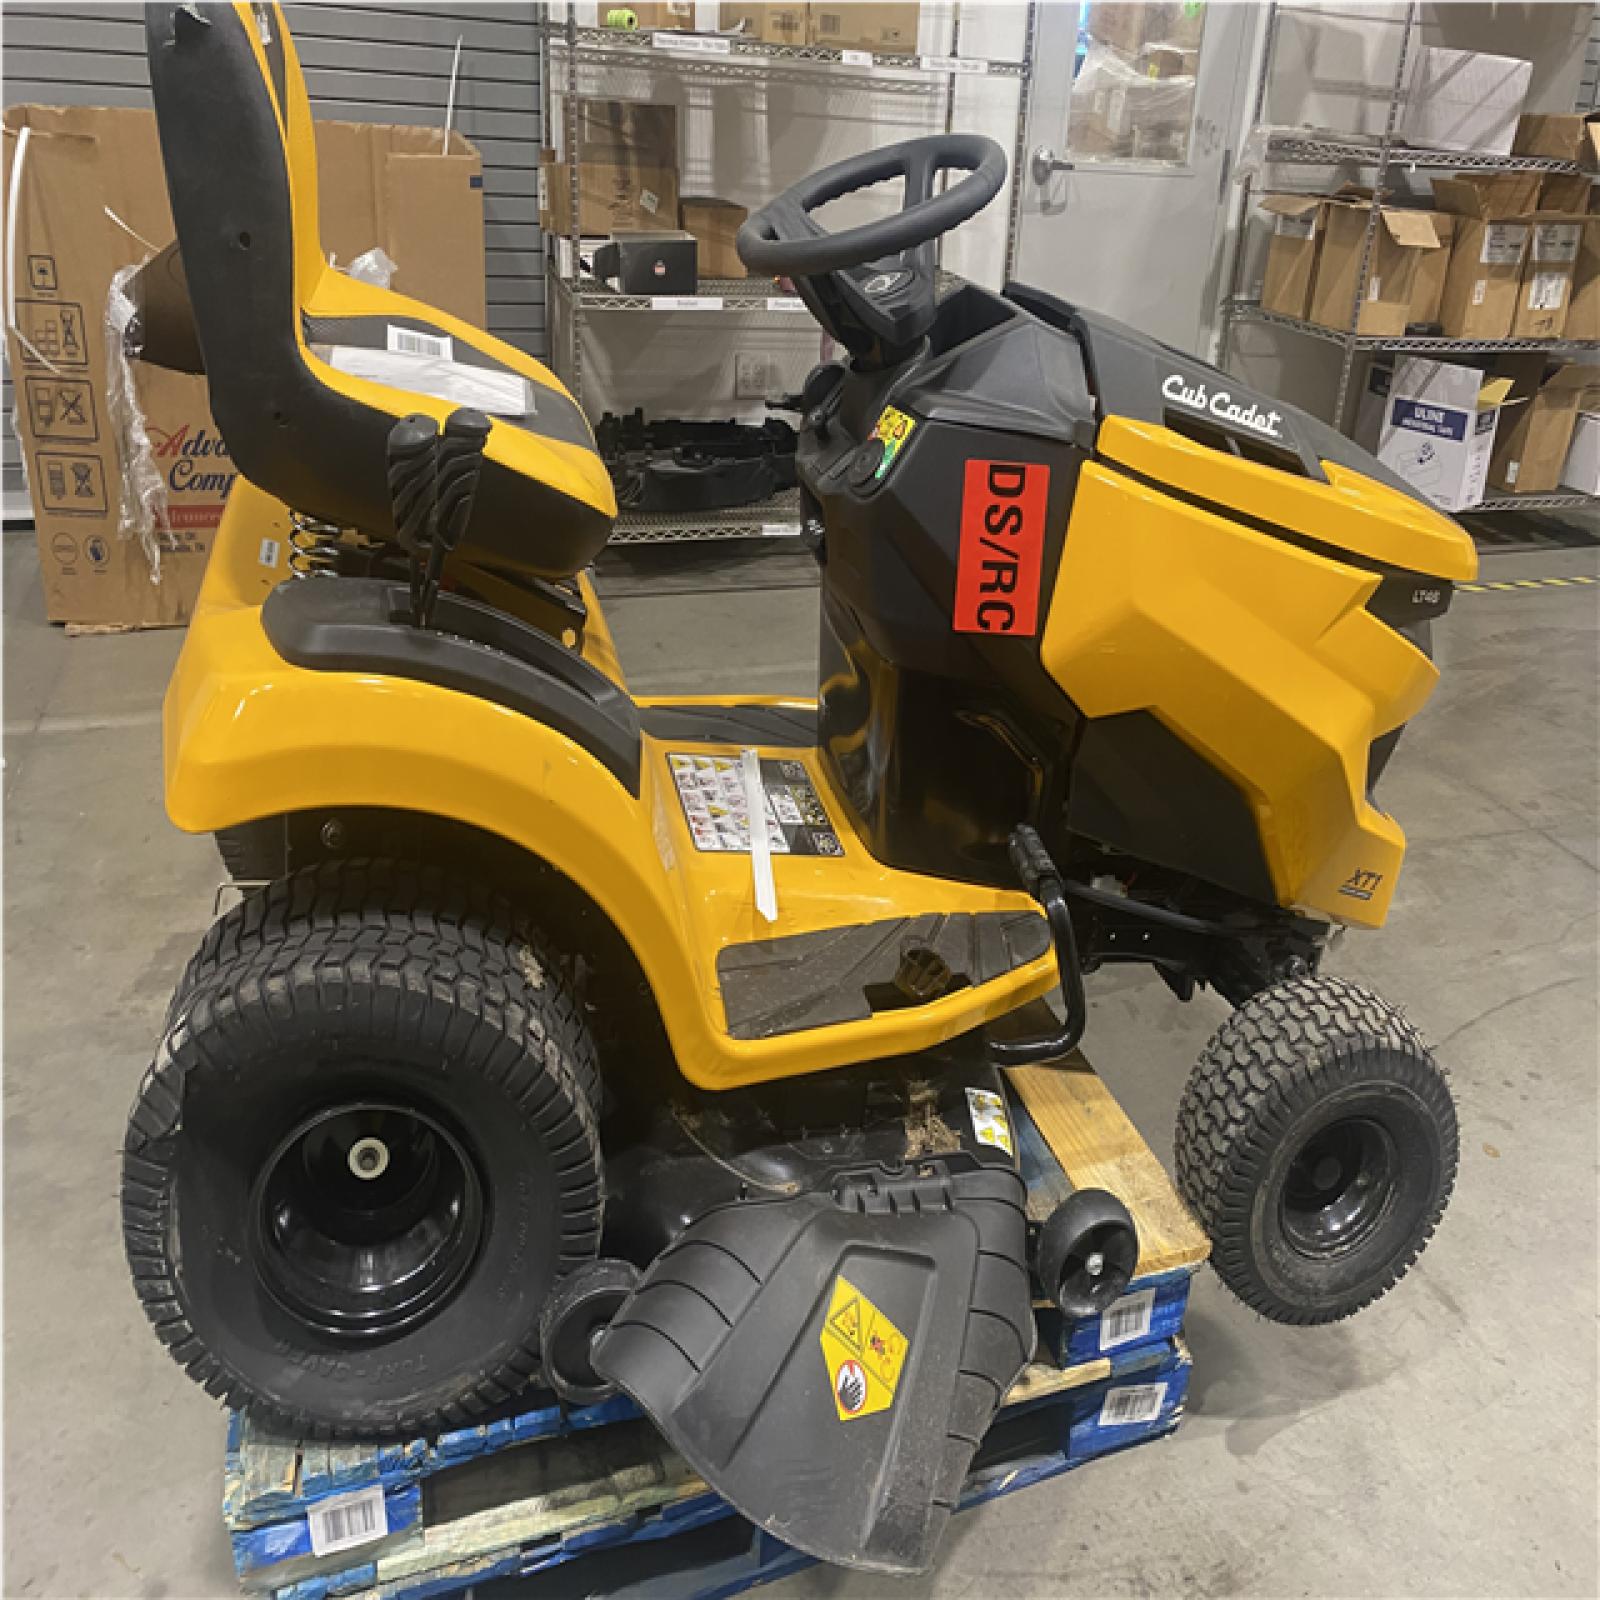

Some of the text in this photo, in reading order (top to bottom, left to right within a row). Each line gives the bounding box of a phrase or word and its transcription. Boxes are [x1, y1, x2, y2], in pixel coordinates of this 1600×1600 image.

[1162, 374, 1281, 436] Cub Cadet
[977, 464, 1026, 631] DS/RC
[1345, 869, 1383, 890] XT1
